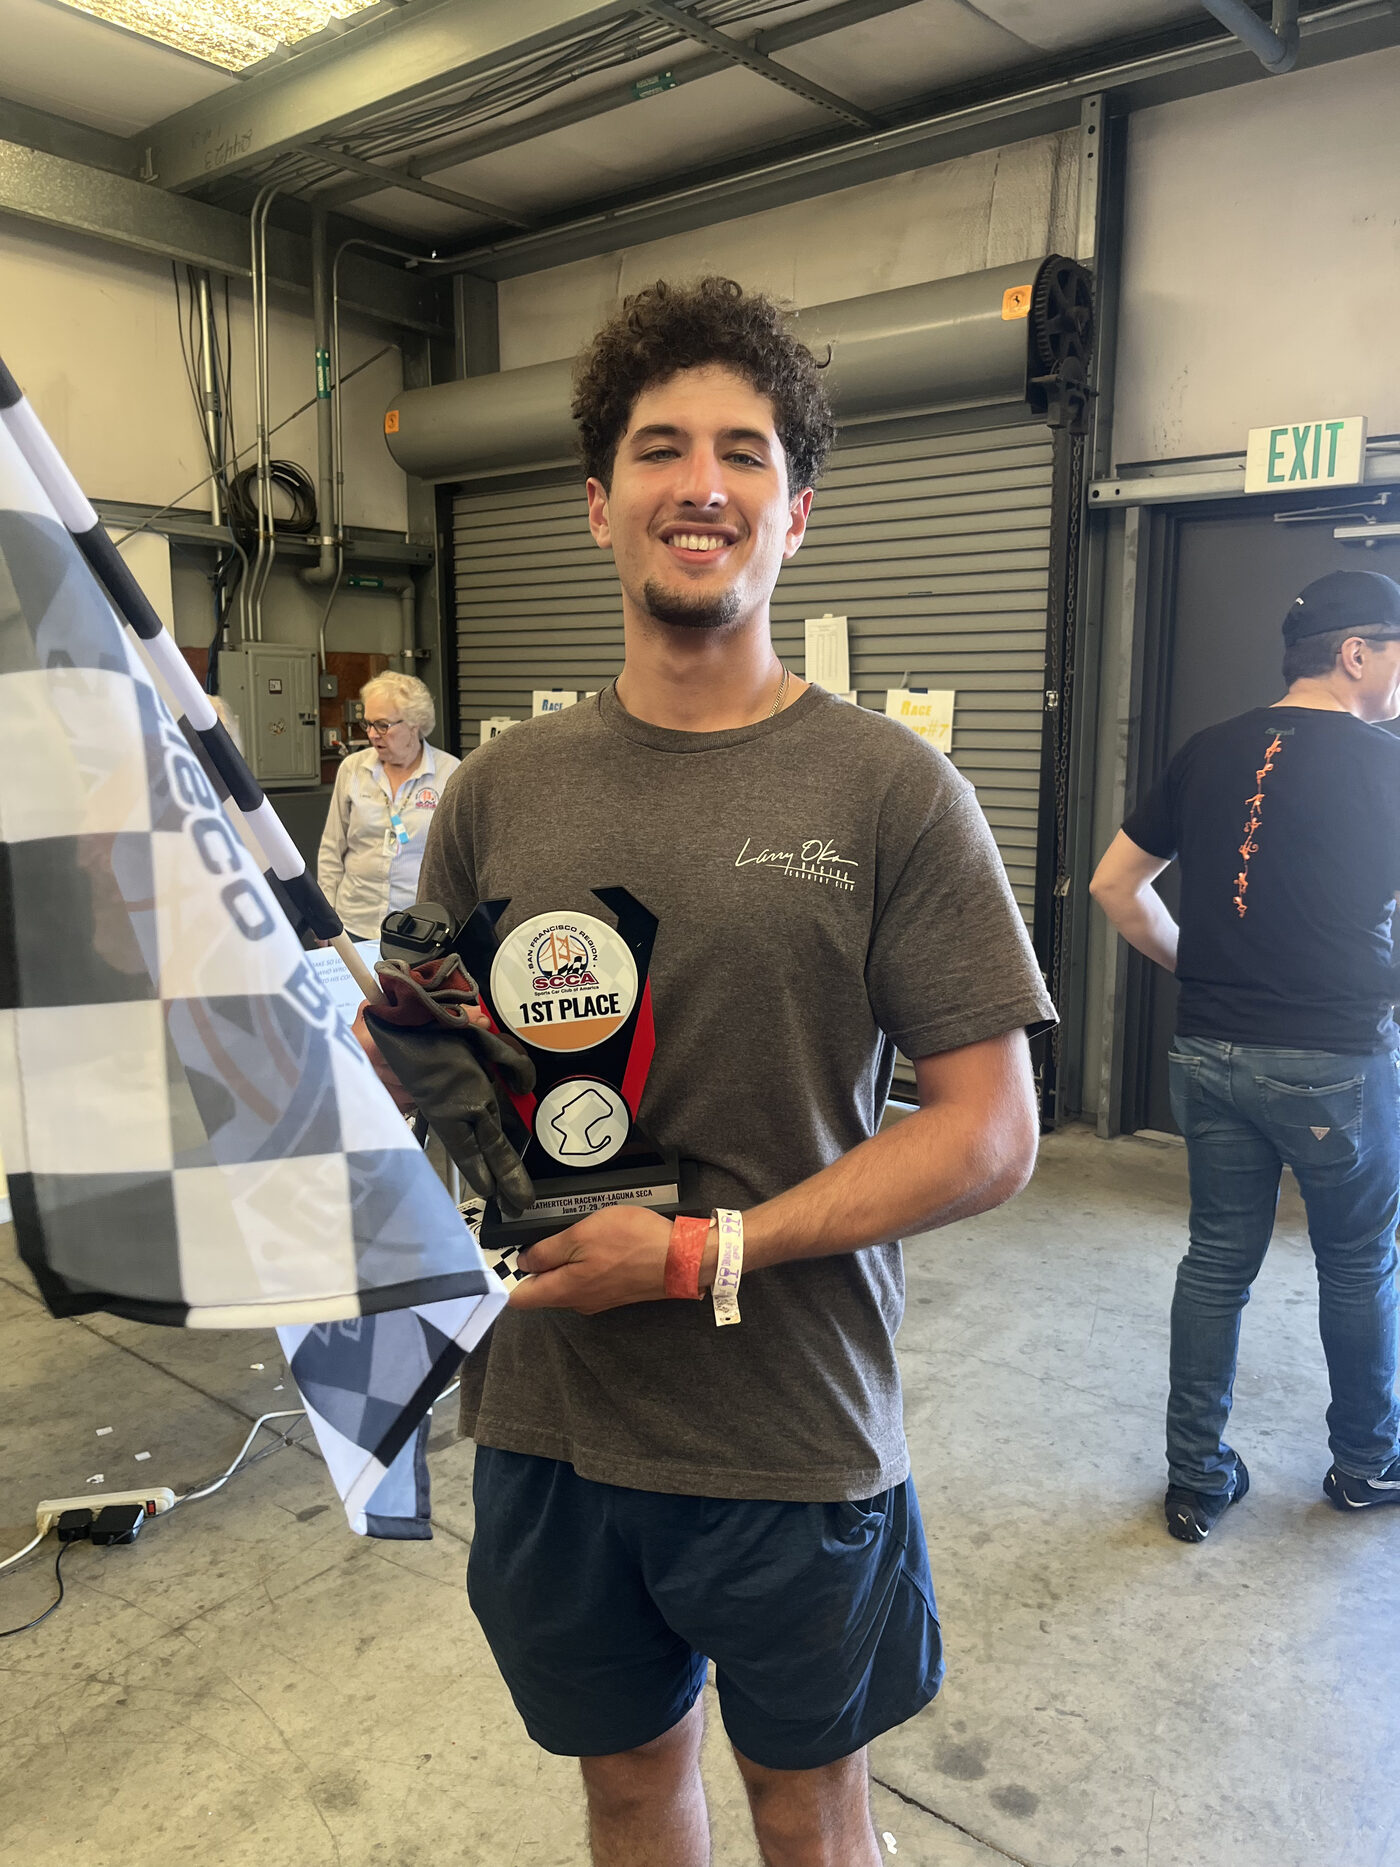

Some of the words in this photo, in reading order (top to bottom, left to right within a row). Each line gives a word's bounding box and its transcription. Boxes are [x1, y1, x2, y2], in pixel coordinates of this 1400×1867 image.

[1267, 422, 1344, 483] EXIT
[901, 701, 932, 716] RACE
[735, 838, 794, 875] Larry
[530, 925, 577, 948] FRANCISCO
[579, 931, 598, 961] REGION
[533, 972, 599, 990] SCCA
[519, 1000, 554, 1024] 1ST
[558, 993, 621, 1020] PLACE
[635, 1189, 653, 1198] SECA
[562, 1206, 577, 1215] June
